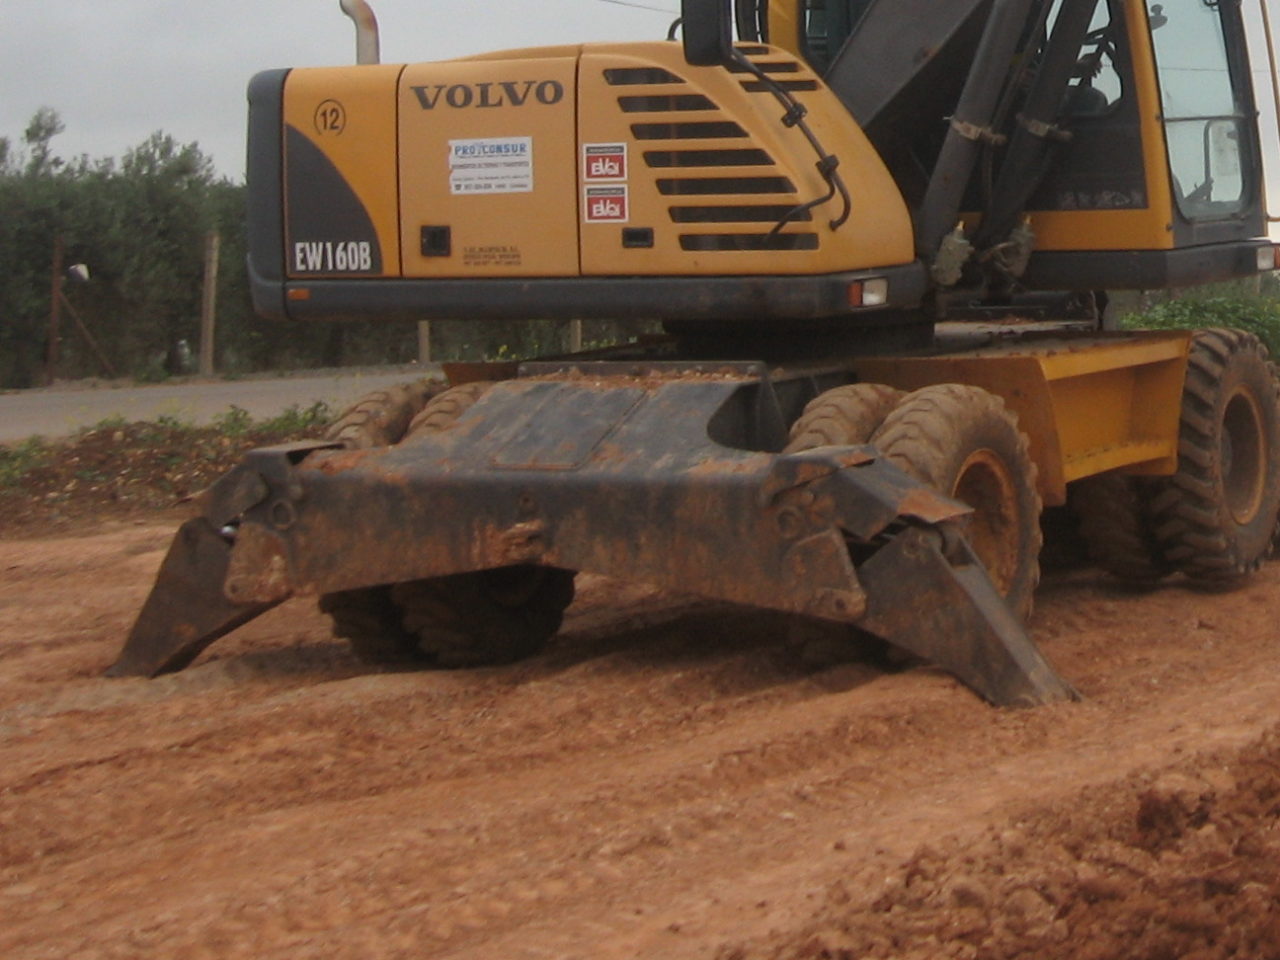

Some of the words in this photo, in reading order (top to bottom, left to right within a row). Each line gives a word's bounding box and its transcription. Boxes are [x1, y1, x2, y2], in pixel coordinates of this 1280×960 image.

[410, 80, 564, 110] VOLVO
[321, 108, 340, 130] 12
[295, 241, 371, 271] EW160B
